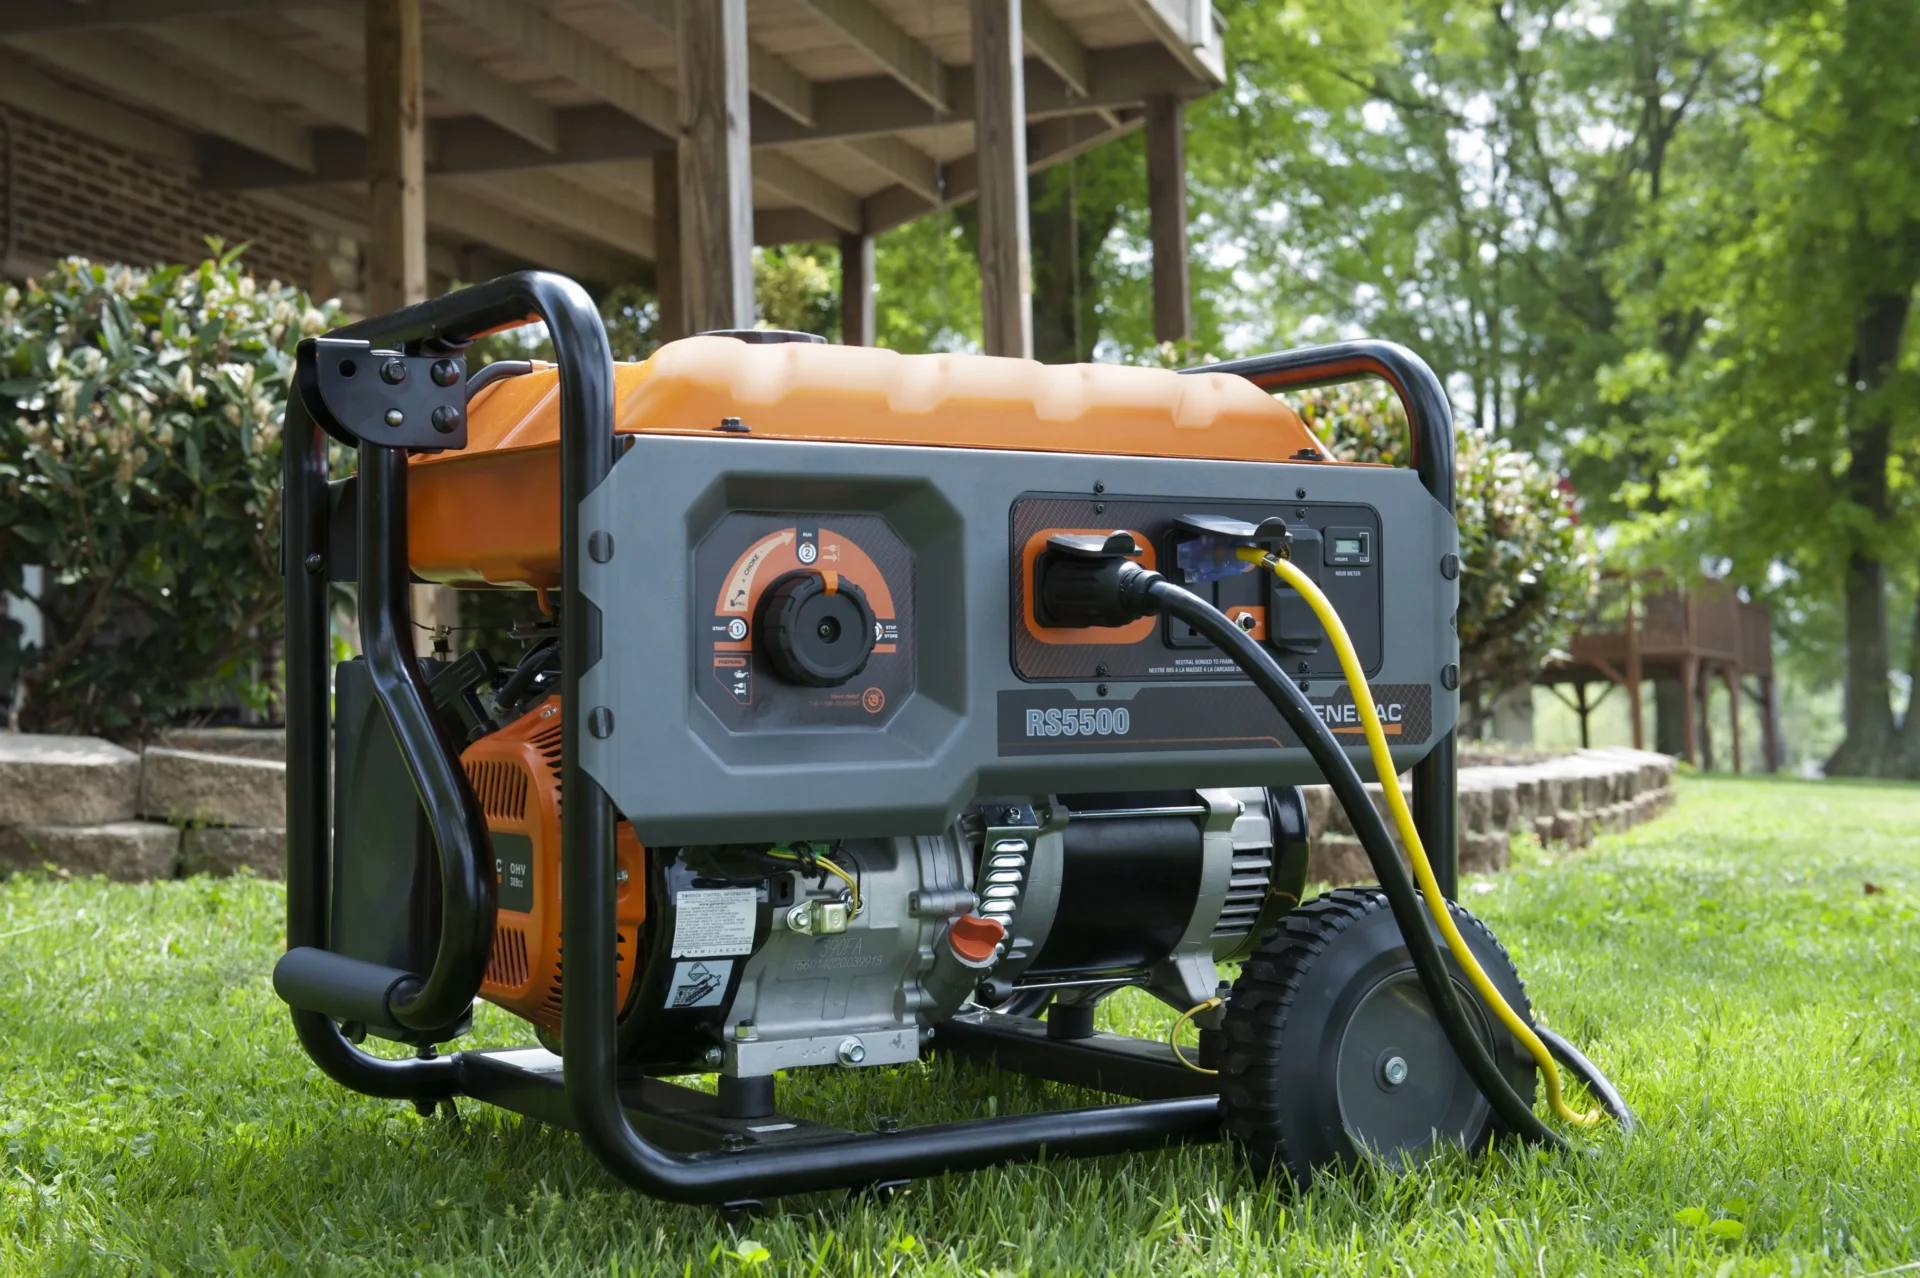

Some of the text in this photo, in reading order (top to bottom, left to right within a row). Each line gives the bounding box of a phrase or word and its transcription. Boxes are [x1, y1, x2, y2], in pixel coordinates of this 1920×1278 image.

[743, 553, 760, 576] CHOKE
[1026, 707, 1130, 737] RS5500
[1312, 703, 1402, 723] ENEAC
[510, 862, 526, 876] OHV
